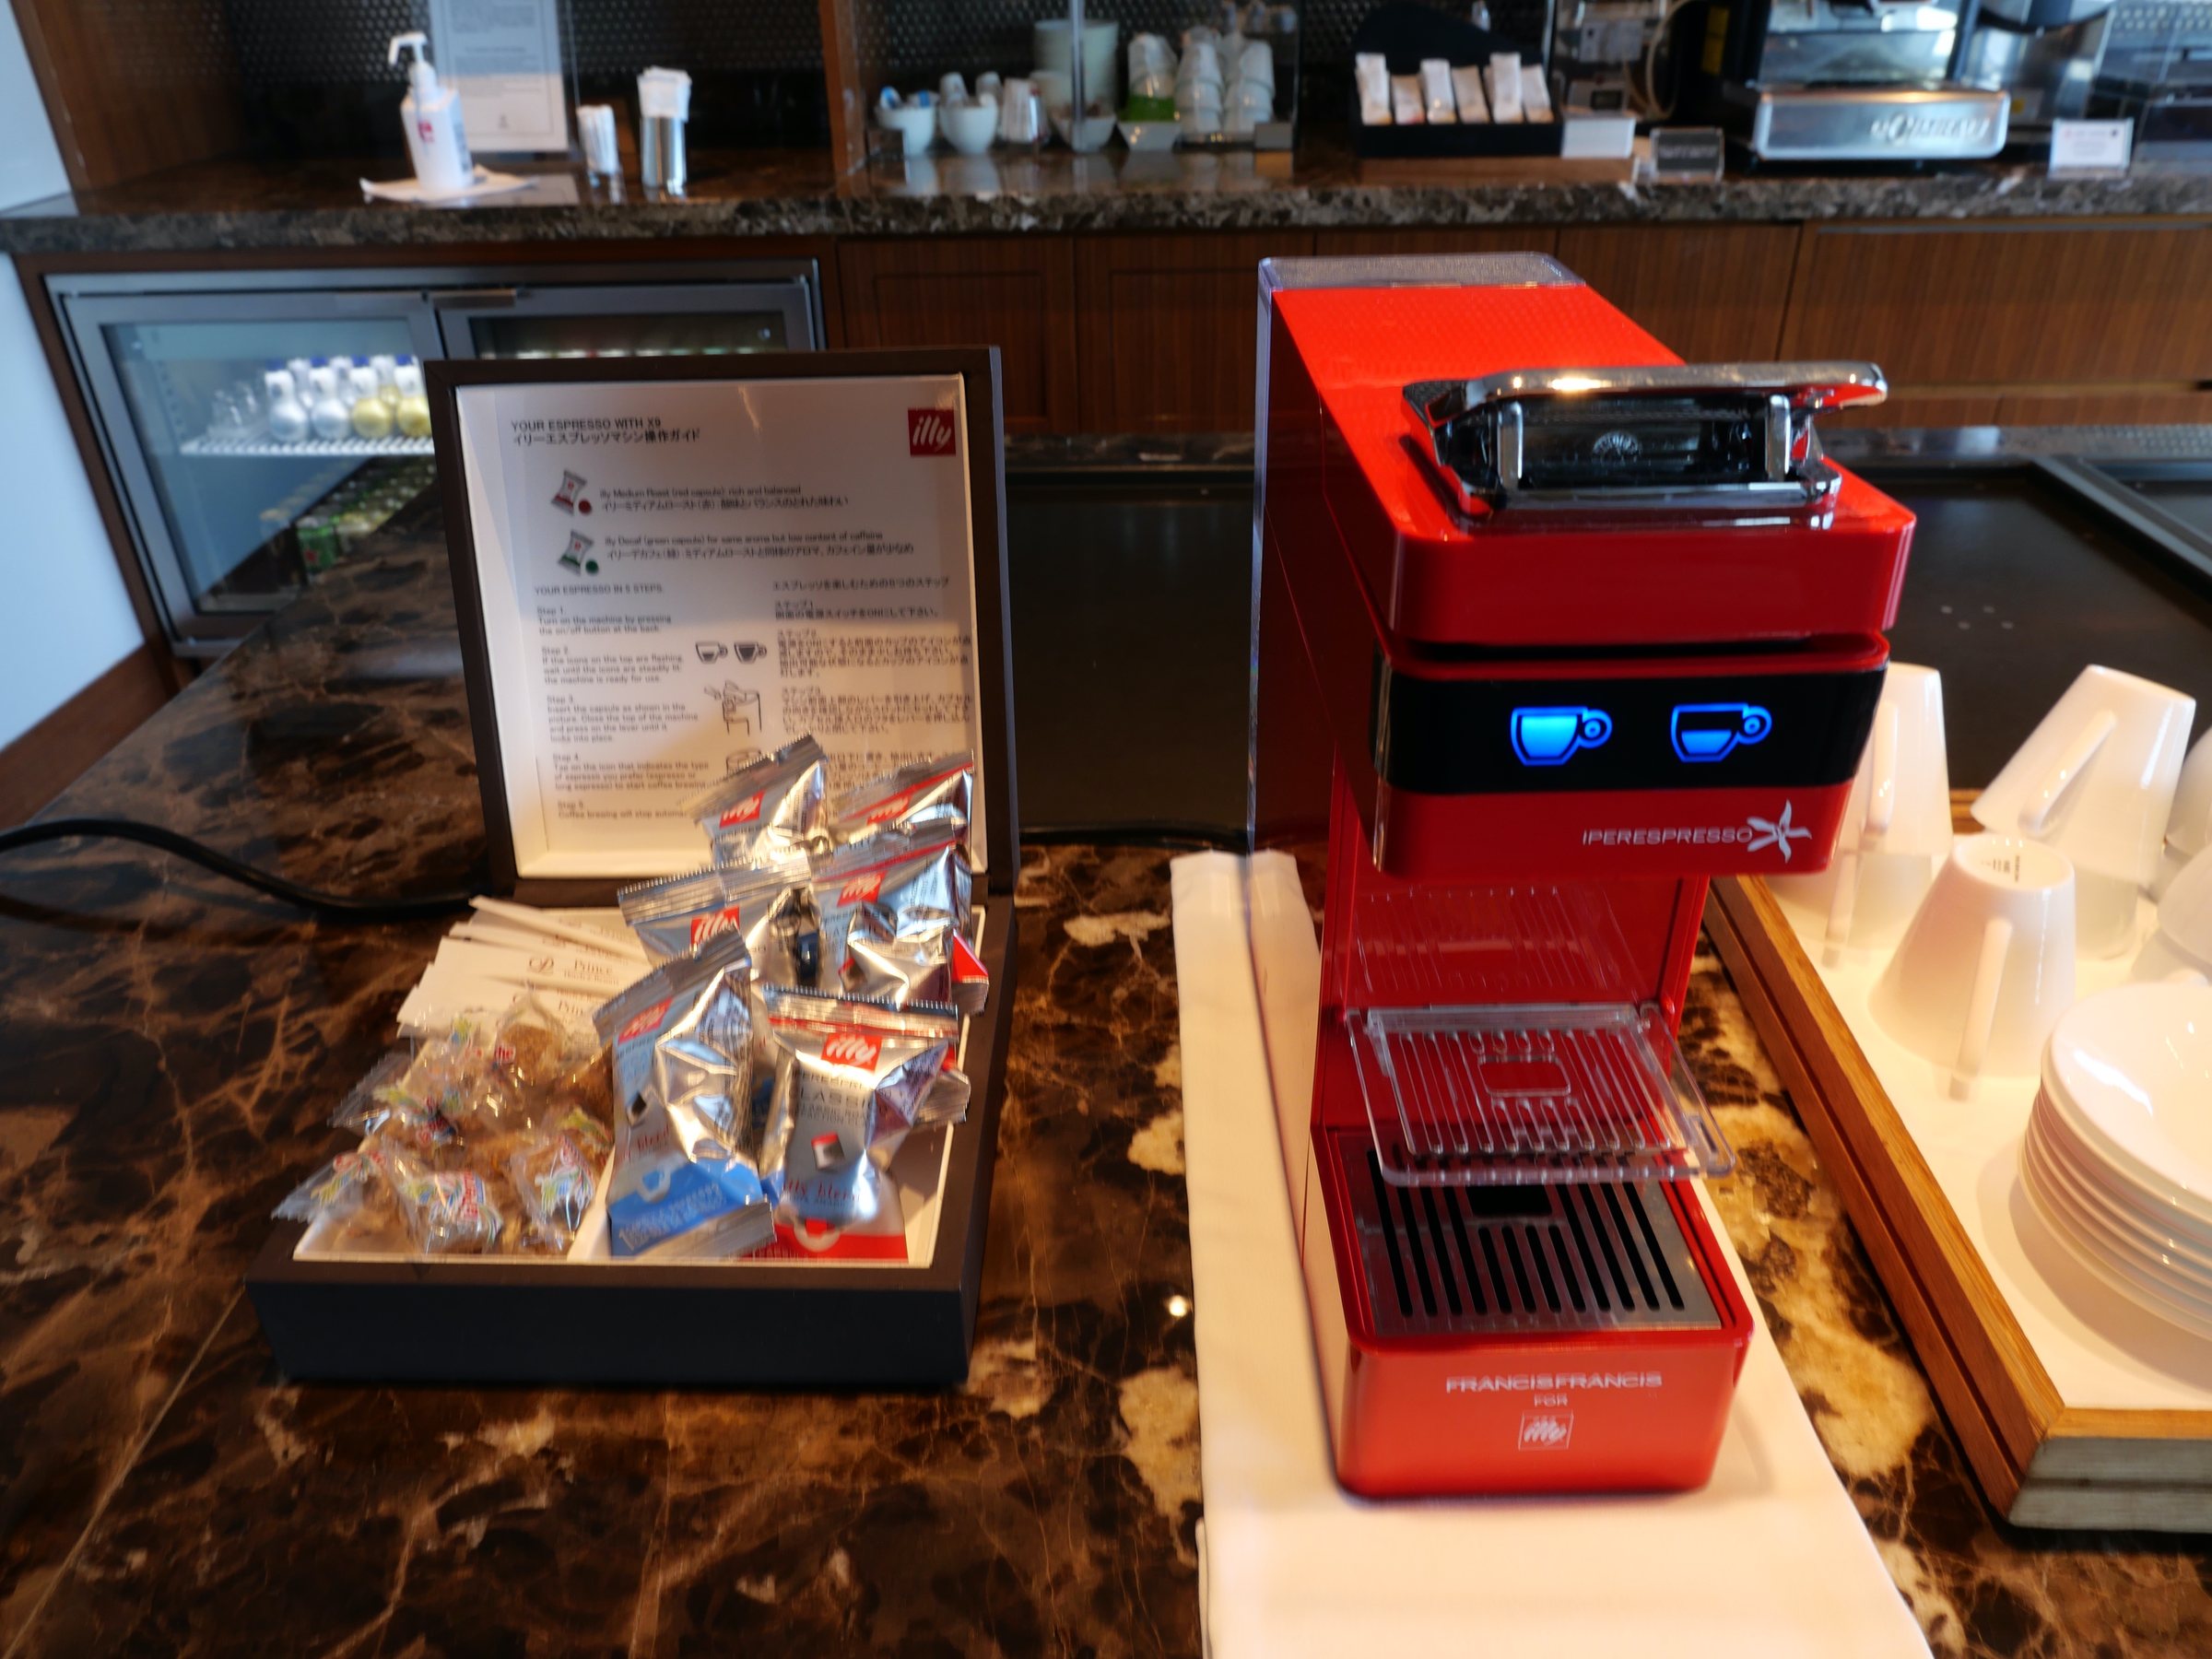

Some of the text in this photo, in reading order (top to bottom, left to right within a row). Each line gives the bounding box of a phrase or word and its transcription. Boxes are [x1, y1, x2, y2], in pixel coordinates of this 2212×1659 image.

[512, 420, 544, 431] YOUR
[549, 419, 610, 430] ESPRESSO
[615, 418, 642, 429] WITH
[912, 415, 952, 452] illy
[535, 585, 559, 595] YOUR
[563, 584, 610, 595] ESPRESSO
[614, 583, 622, 593] IN
[633, 582, 662, 594] STEPS
[1583, 827, 1753, 846] IPERESPRESSO
[826, 1033, 877, 1065] illy
[1534, 1394, 1568, 1406] FOR
[1524, 1416, 1567, 1446] illy
